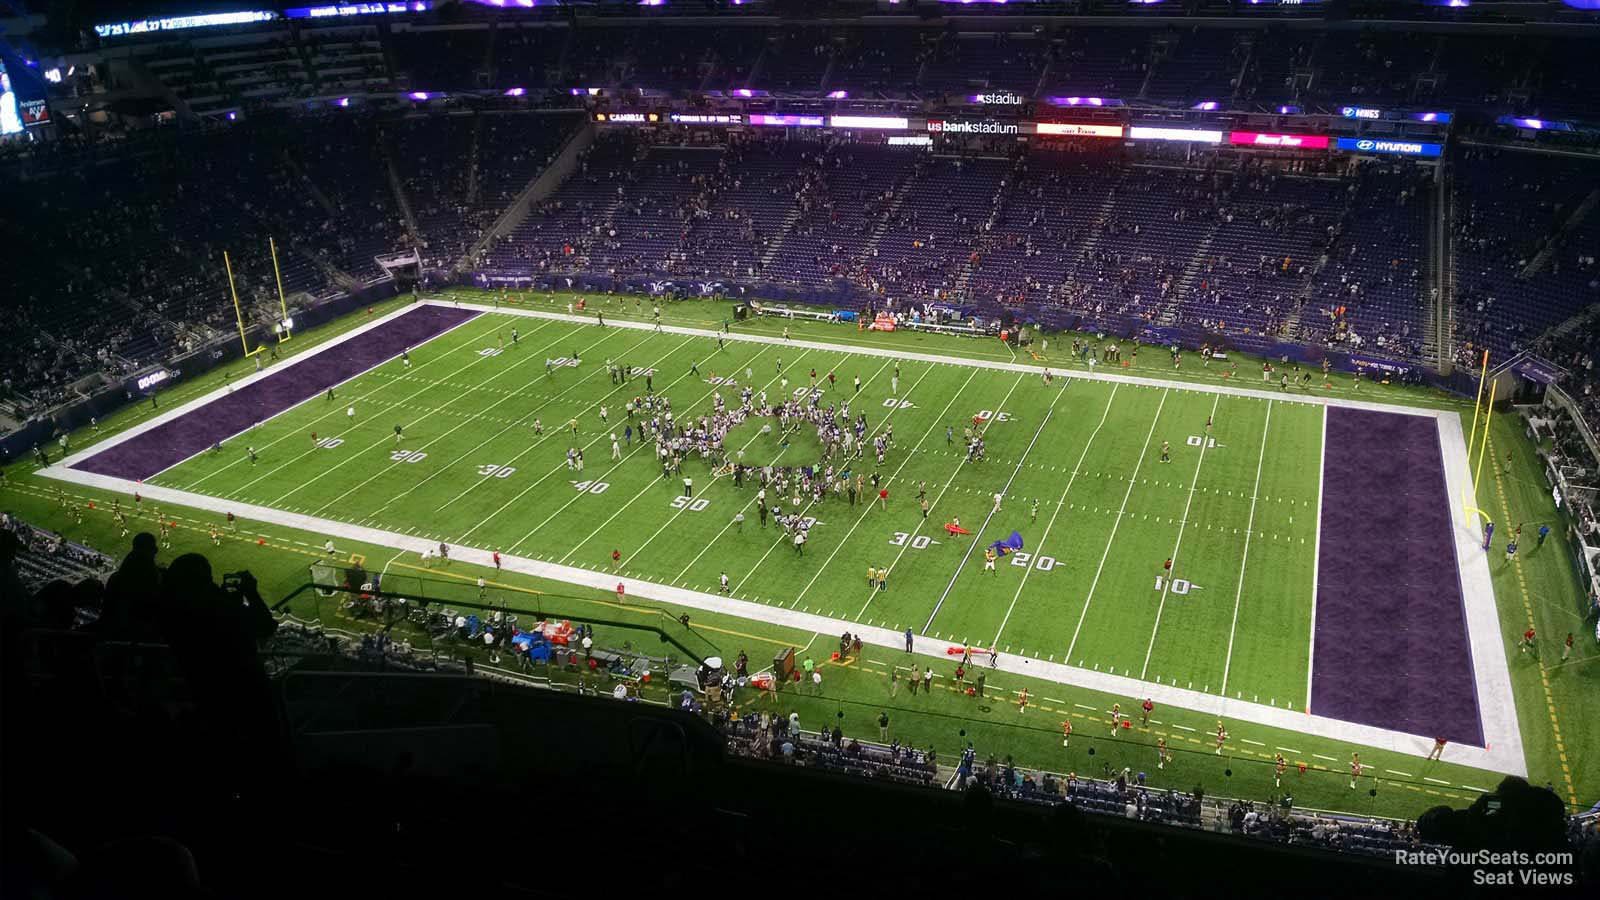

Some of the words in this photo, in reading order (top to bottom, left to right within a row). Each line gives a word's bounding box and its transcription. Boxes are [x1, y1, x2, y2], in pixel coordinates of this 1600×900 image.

[1376, 142, 1422, 153] HYUNDAI
[882, 398, 914, 409] 40
[979, 410, 1012, 422] 30
[1186, 435, 1216, 448] 10
[390, 449, 428, 464] 20
[477, 464, 517, 479] 30
[574, 480, 611, 494] 40
[669, 495, 710, 511] 50
[888, 531, 932, 549] 30
[1010, 551, 1057, 571] 20
[1154, 575, 1191, 595] 10
